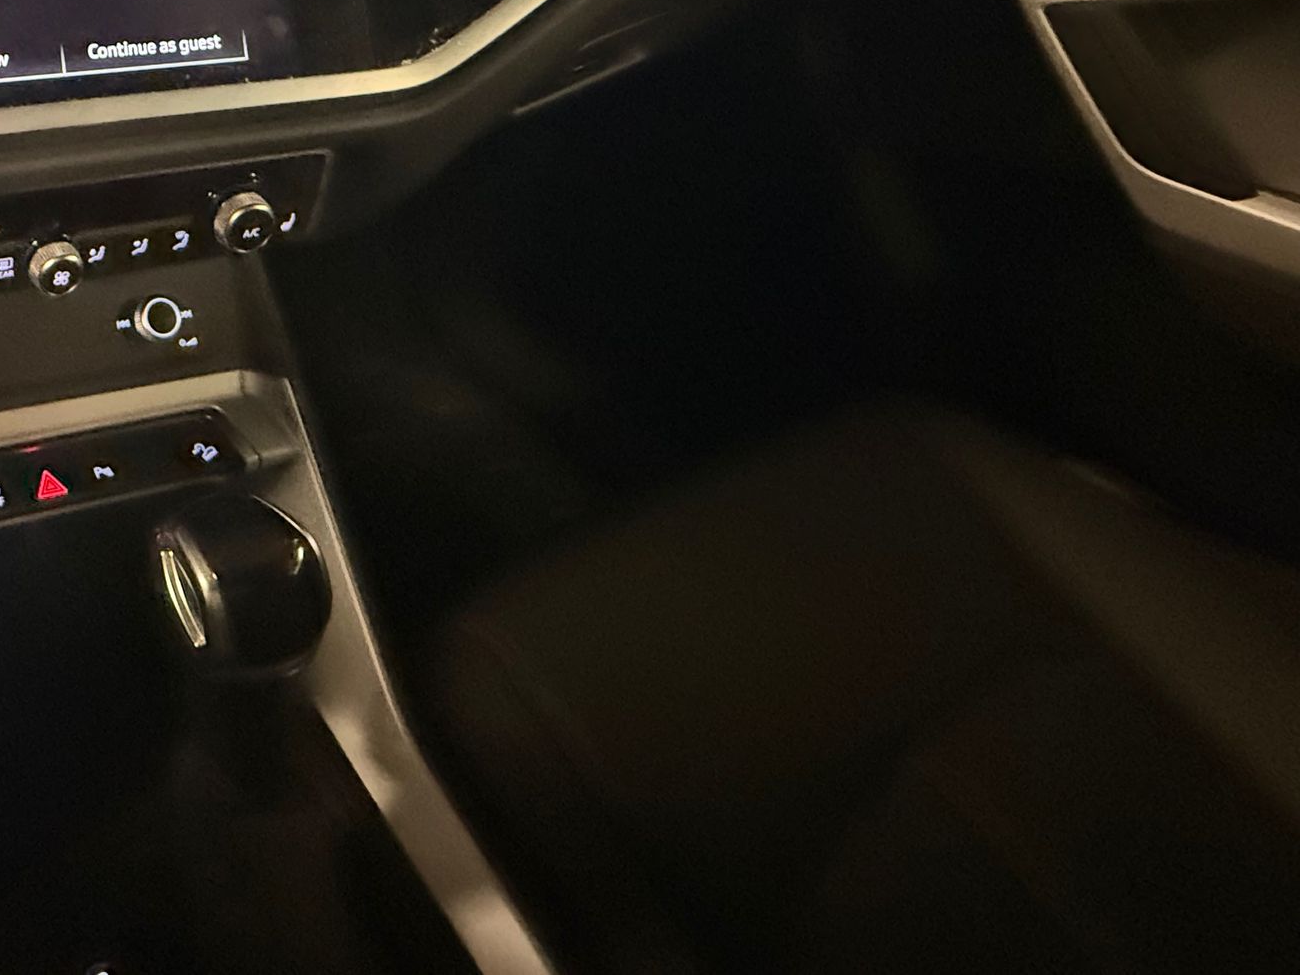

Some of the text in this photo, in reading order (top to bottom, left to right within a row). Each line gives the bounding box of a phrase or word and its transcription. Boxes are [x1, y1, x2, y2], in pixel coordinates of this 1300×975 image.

[87, 34, 222, 61] Continue as guest
[242, 227, 261, 239] A/C
